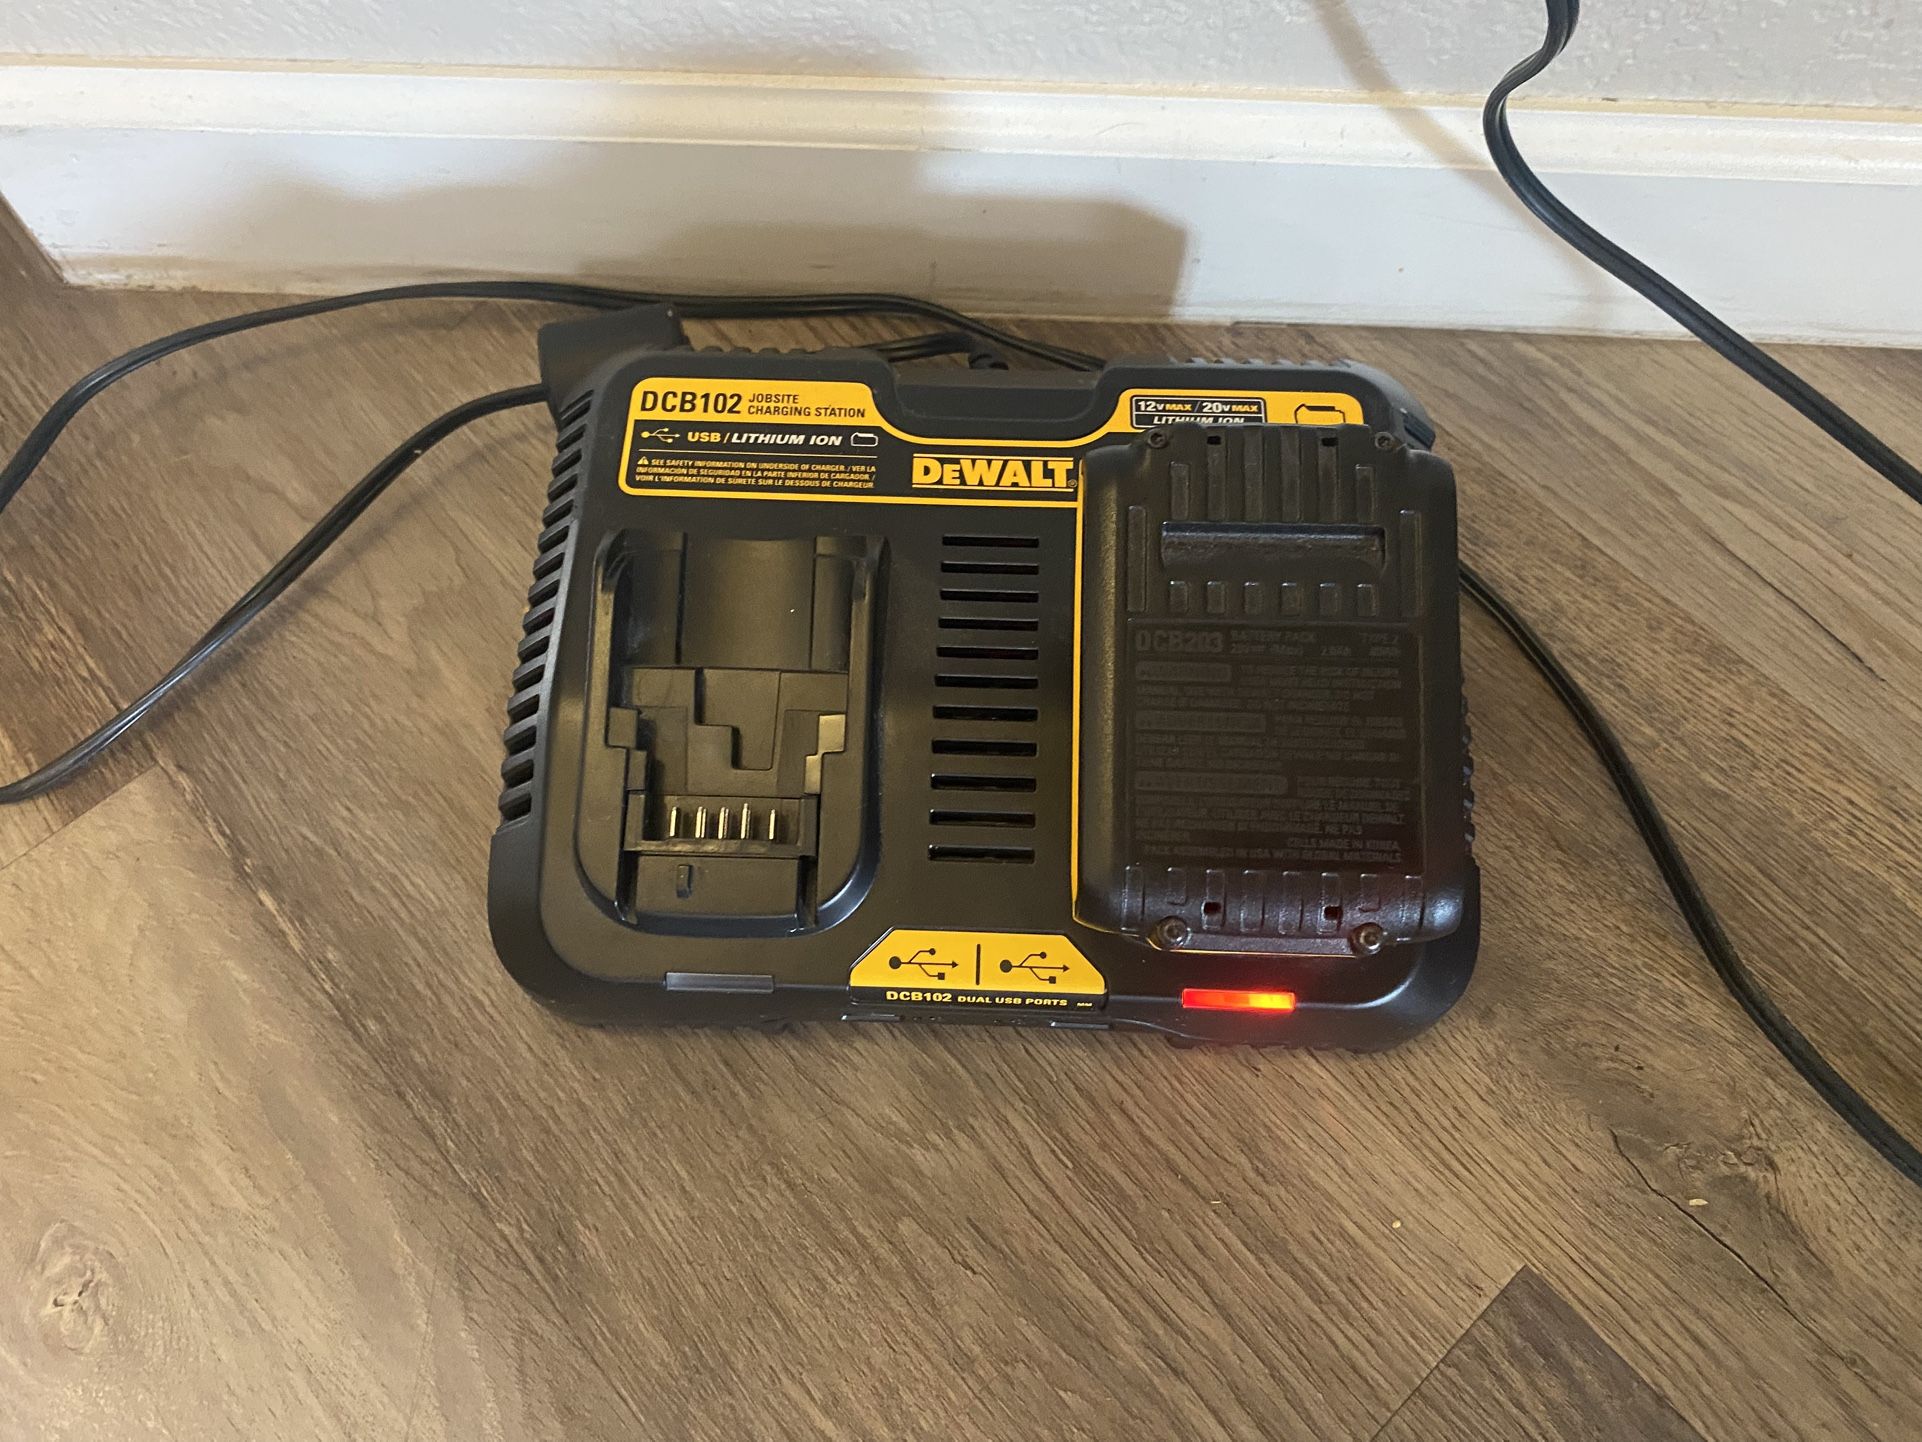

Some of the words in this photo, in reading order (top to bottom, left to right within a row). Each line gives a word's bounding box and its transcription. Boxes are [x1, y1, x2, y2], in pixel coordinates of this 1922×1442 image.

[640, 390, 742, 414] DCB102
[749, 393, 799, 404] JOBSITE
[748, 405, 811, 416] CHARGING
[814, 406, 866, 418] STATION
[687, 431, 721, 443] USB
[809, 435, 843, 446] ION
[666, 459, 693, 467] SAFETY
[694, 460, 745, 468] INFORMATION
[758, 462, 799, 470] UNDERSIDE
[655, 476, 715, 484] L'INFORMATION
[886, 991, 952, 1003] DCB102
[957, 995, 992, 1004] DUAL
[995, 996, 1022, 1005] USB
[1025, 998, 1068, 1006] PORTS
